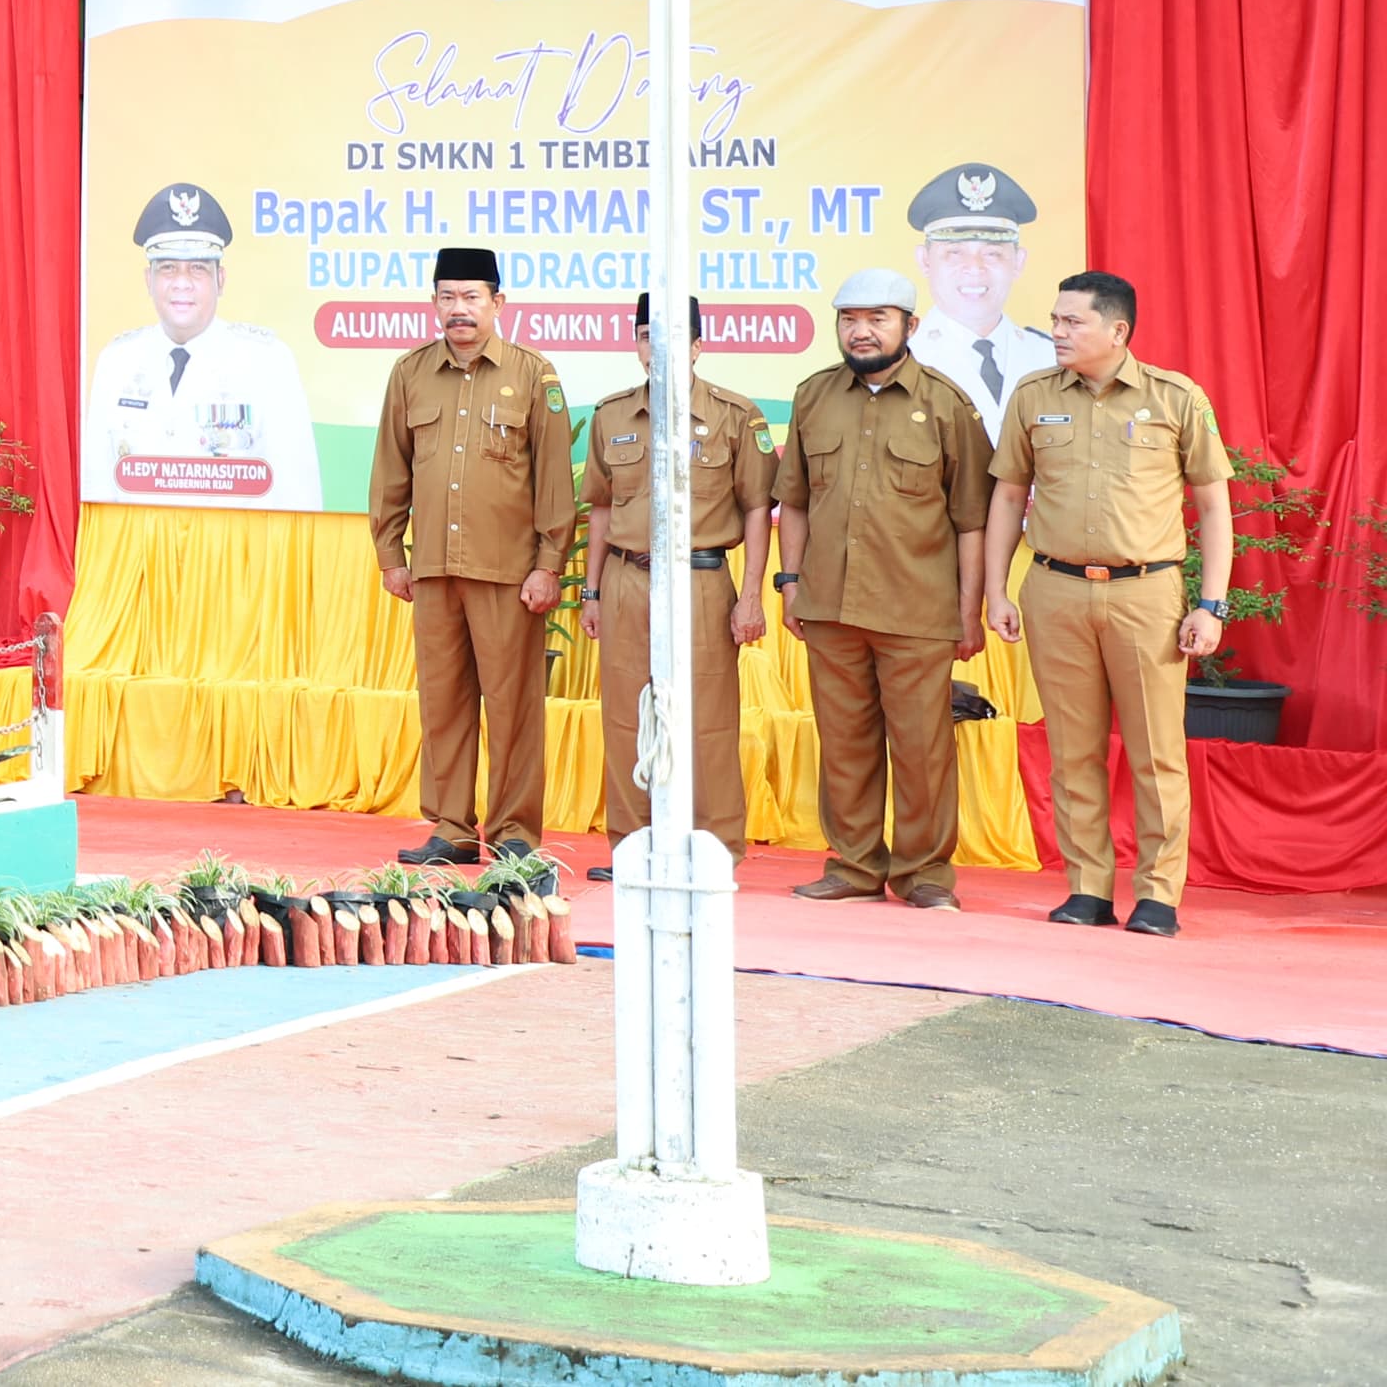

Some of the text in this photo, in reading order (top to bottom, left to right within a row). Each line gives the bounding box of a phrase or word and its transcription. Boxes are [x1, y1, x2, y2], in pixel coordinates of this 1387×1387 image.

[367, 31, 753, 143] Selamat Dang
[347, 138, 776, 170] DI SMKN 1 TEMBIHAN
[254, 188, 388, 245] Bapak
[405, 190, 448, 233] H.
[701, 187, 793, 244] ST.,
[811, 187, 880, 233] MT
[309, 251, 438, 287] BUPAT
[699, 251, 820, 289] HILIR
[331, 312, 427, 338] ALUMNI
[529, 313, 603, 341] SMKN
[610, 314, 620, 341] 1
[122, 462, 158, 477] H.EDY
